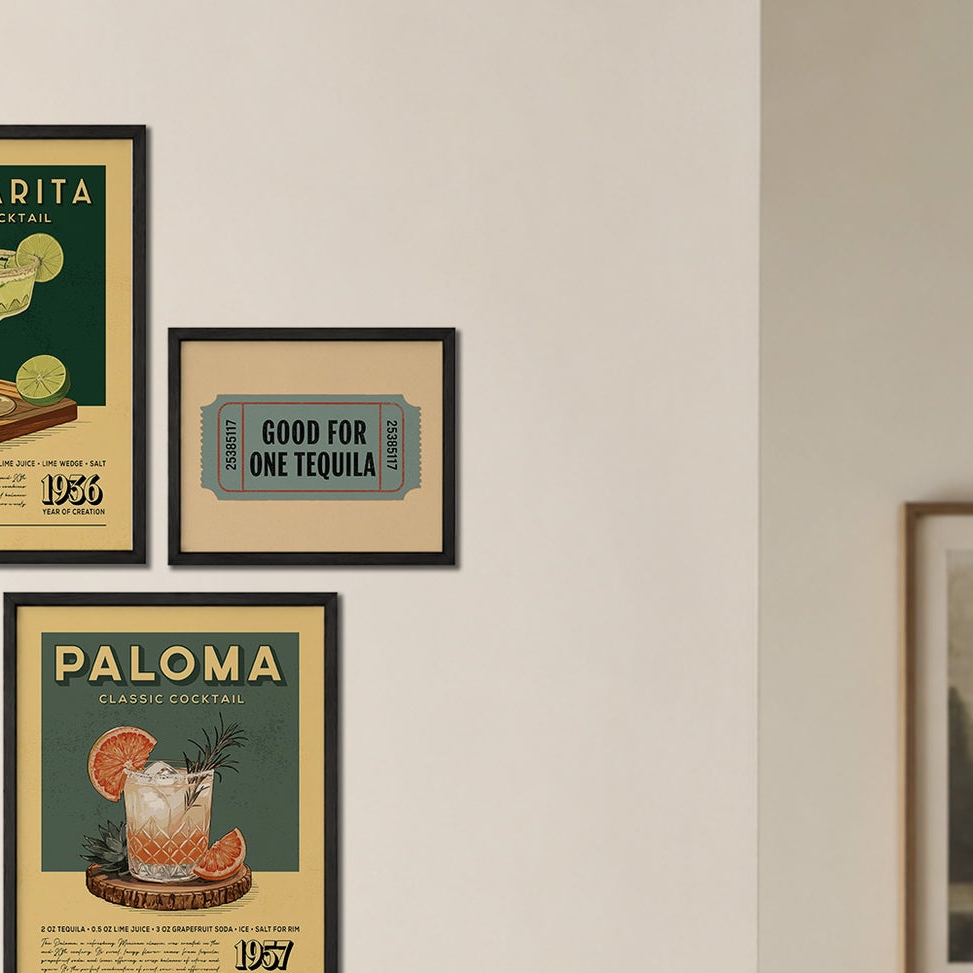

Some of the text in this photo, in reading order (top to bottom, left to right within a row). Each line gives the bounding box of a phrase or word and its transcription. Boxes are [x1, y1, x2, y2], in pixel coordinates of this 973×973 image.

[225, 419, 237, 471] 25385117
[262, 419, 367, 445] GOOD FOR
[386, 420, 398, 471] 25385117
[249, 452, 376, 480] ONE TEQUILA
[41, 474, 104, 505] 1936
[54, 644, 288, 687] PALOMA
[99, 694, 245, 704] CLASSIC COCKTAIL
[234, 939, 294, 971] 1957
